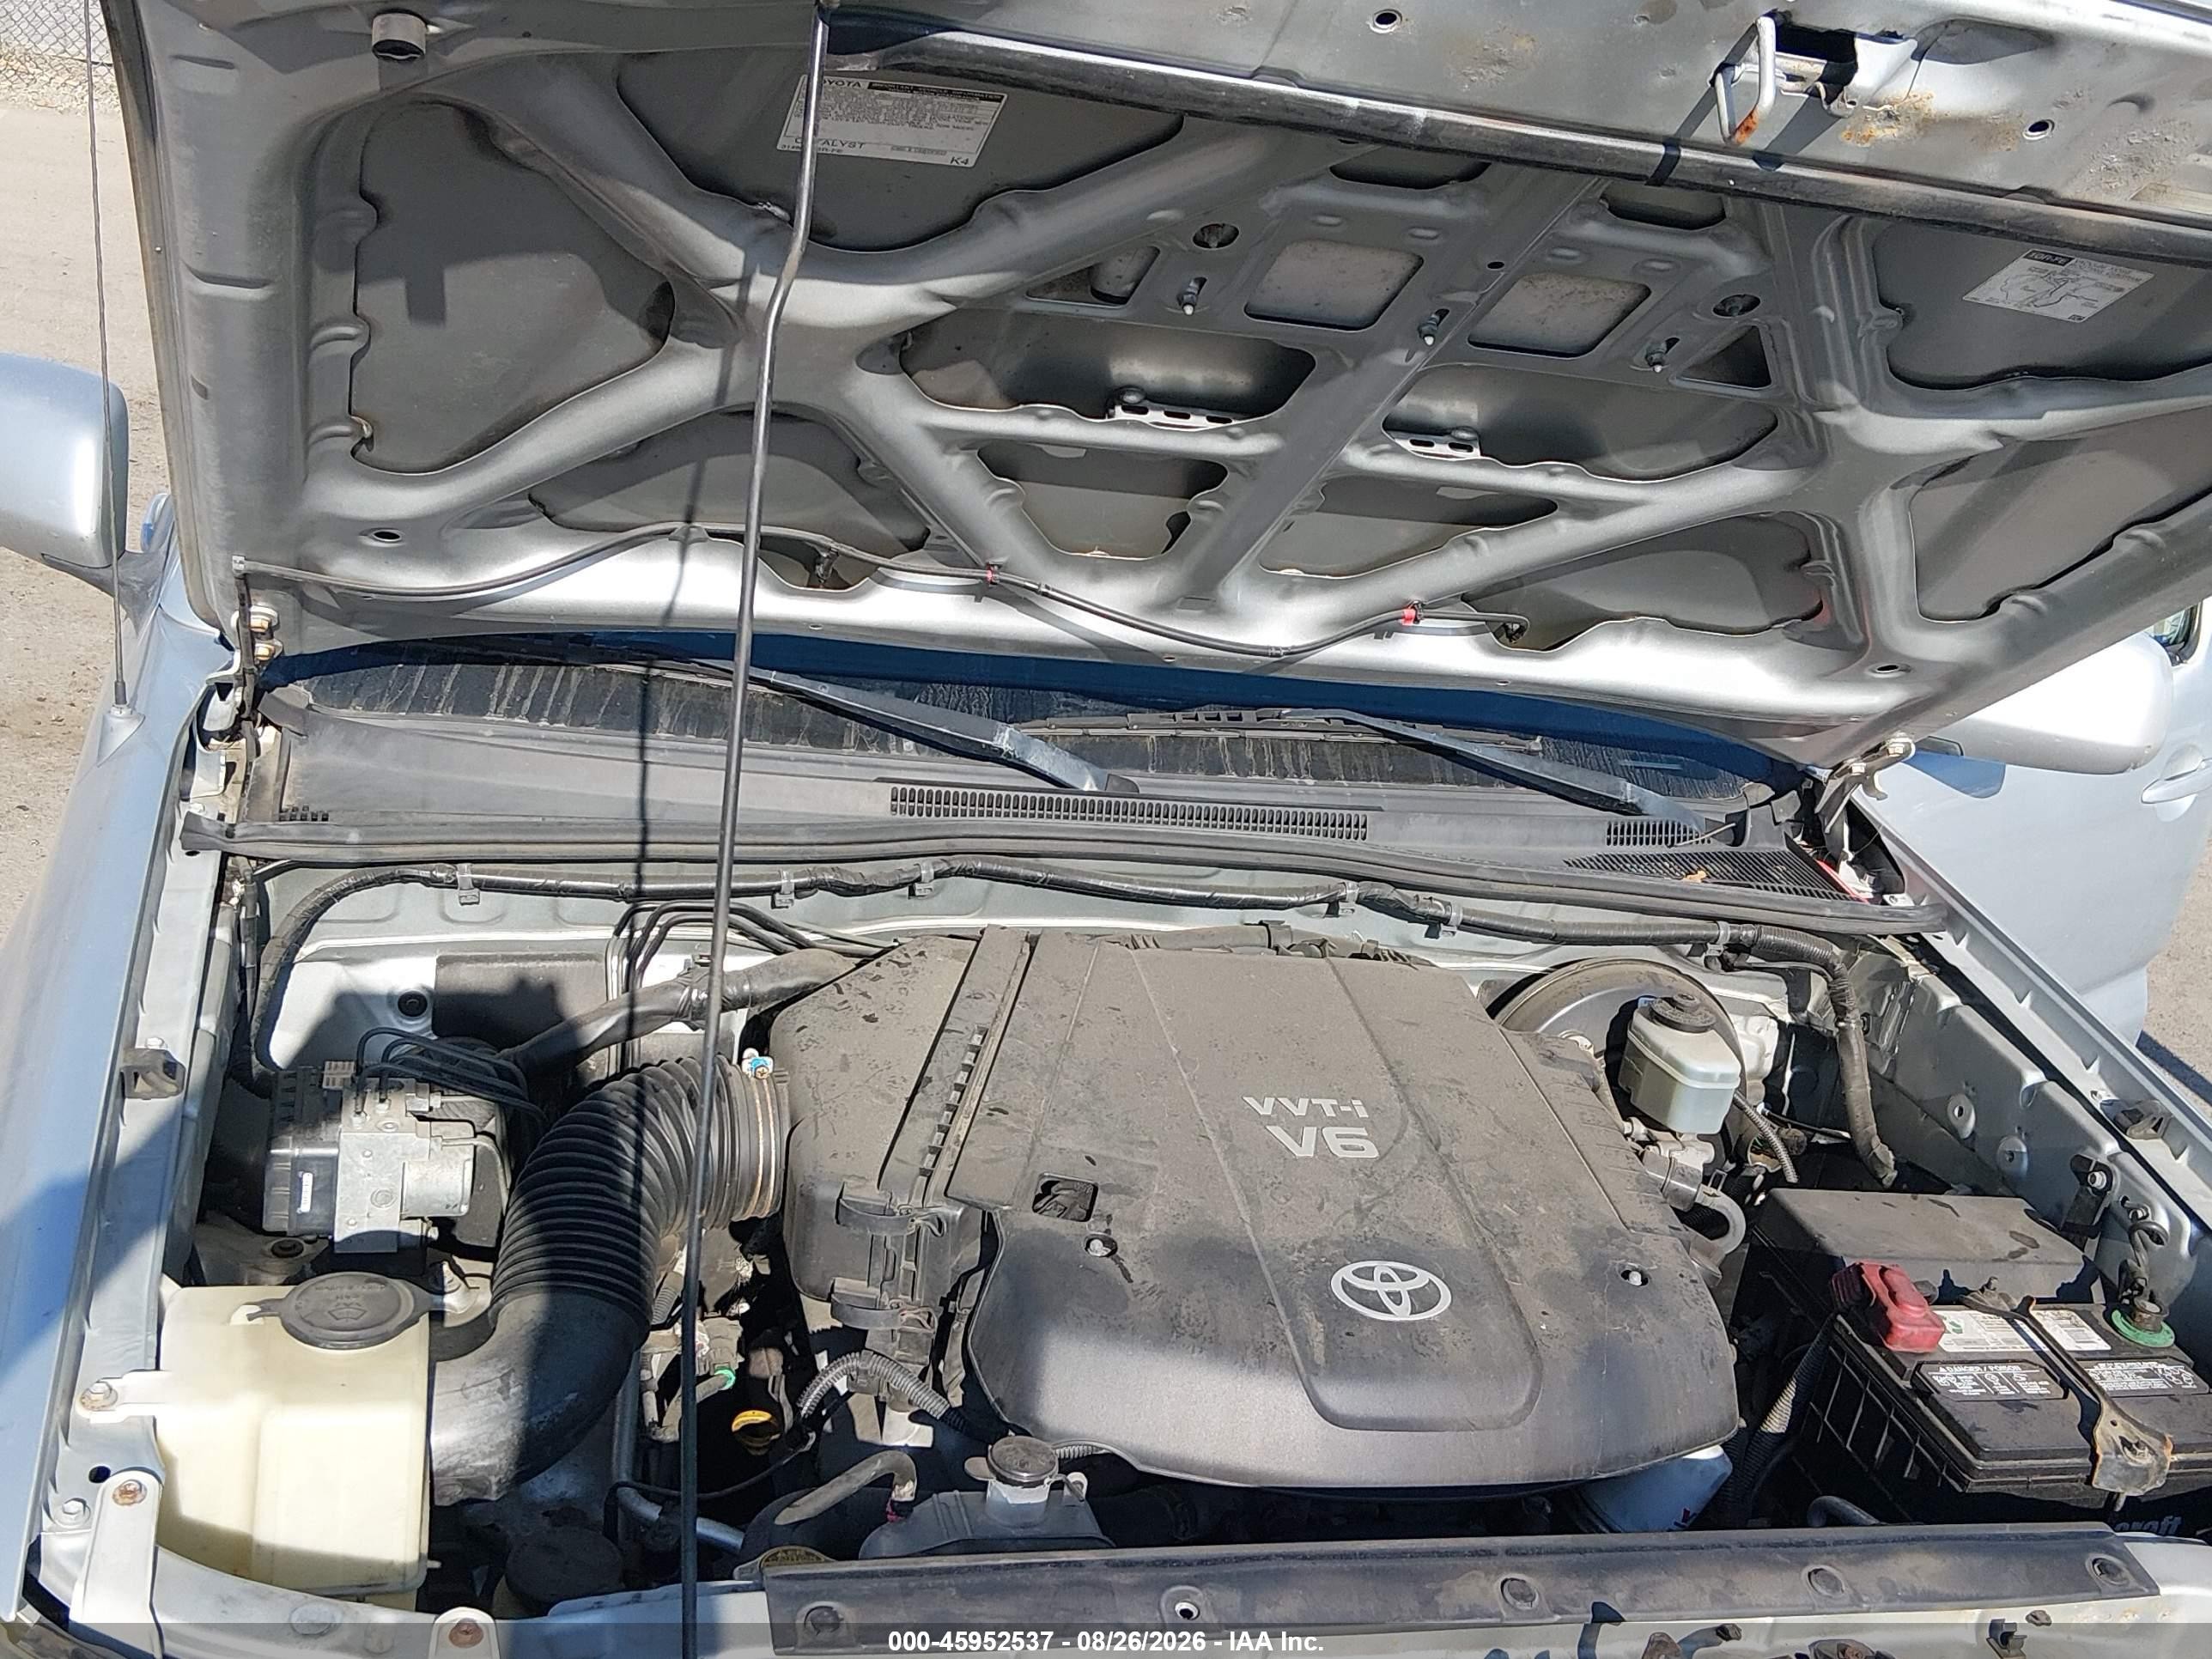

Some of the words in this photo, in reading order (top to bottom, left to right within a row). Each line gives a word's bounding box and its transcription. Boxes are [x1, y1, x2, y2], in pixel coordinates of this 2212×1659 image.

[822, 79, 862, 88] YOTA
[794, 137, 866, 149] CALYST
[950, 156, 969, 165] K4
[1242, 1097, 1369, 1118] VVT-i
[1266, 1126, 1379, 1158] V6
